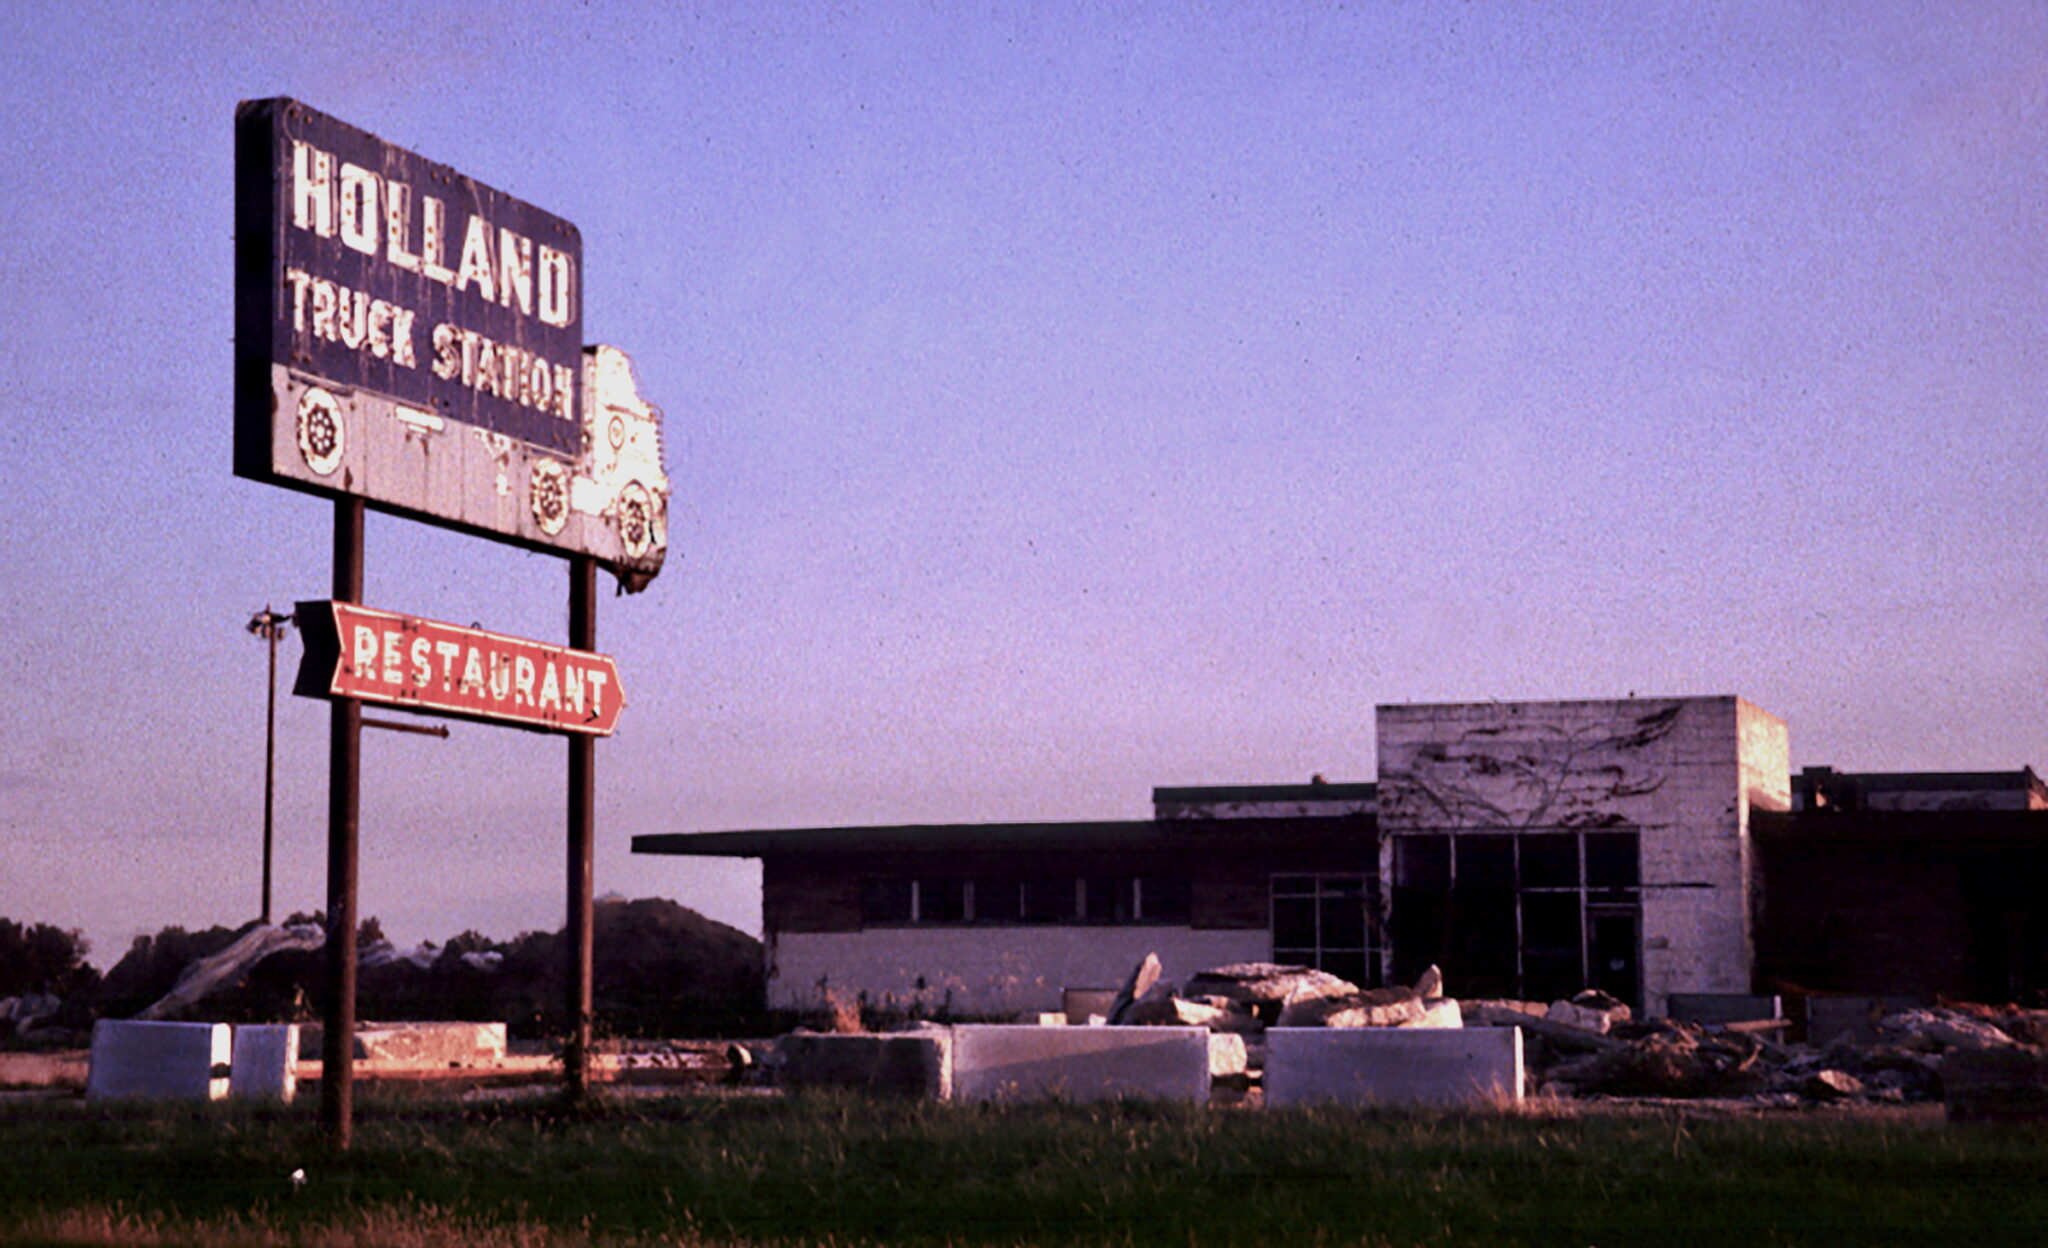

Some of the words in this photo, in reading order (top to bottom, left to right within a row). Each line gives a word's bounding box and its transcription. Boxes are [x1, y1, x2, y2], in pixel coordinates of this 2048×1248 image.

[293, 140, 576, 328] HOLLAND
[286, 268, 416, 369] TRUCK
[432, 323, 573, 420] STATION
[354, 625, 607, 715] RESTAURANT
